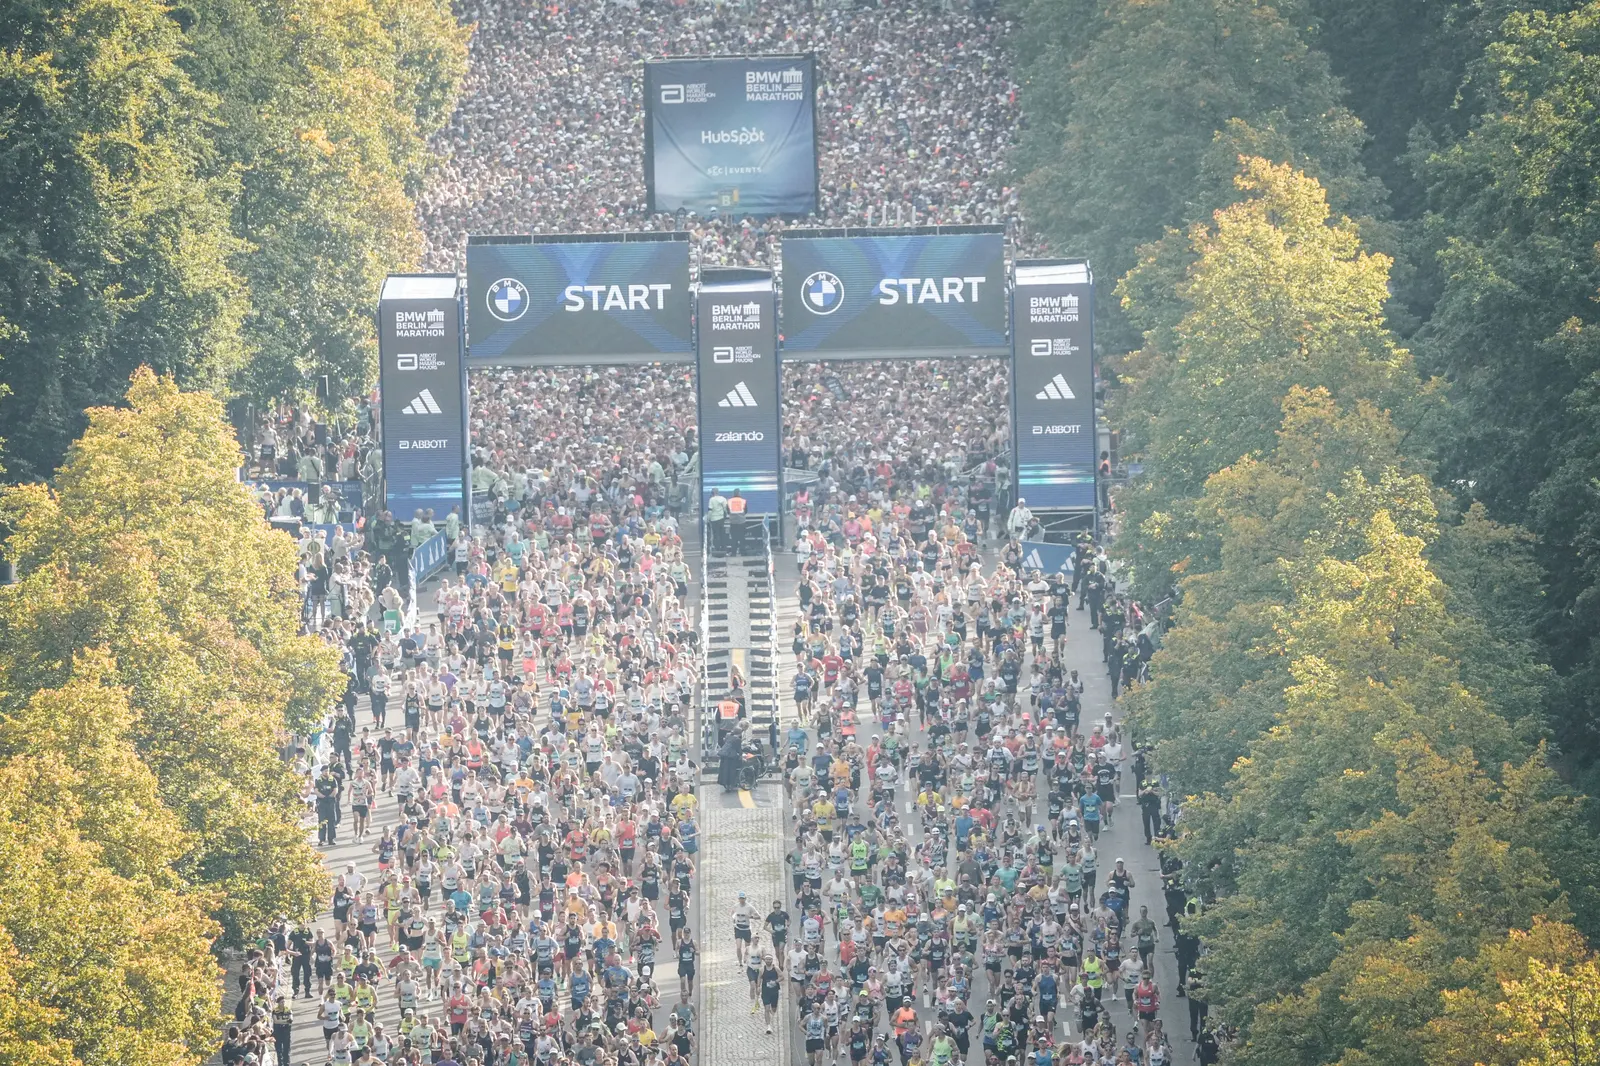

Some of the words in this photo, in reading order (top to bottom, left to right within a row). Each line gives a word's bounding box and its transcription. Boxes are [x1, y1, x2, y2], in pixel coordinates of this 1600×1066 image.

[746, 71, 782, 84] BMW
[746, 84, 782, 92] BERLIN
[746, 92, 803, 101] MARATHON
[701, 127, 765, 145] HubSpot
[807, 273, 838, 286] BMW
[492, 280, 523, 293] BMW
[879, 276, 986, 305] START
[565, 284, 671, 312] START
[1030, 296, 1061, 307] BMW
[712, 304, 742, 315] BMW
[1030, 307, 1061, 315] BERLIN
[396, 311, 426, 322] BMW
[712, 315, 743, 323] BERLIN
[1030, 314, 1079, 323] MARATHON
[396, 322, 427, 330] BERLIN
[712, 322, 760, 330] MARATHON
[396, 329, 445, 337] MARATHON
[1044, 424, 1081, 434] ABBOTT
[715, 431, 764, 442] zalando
[411, 439, 448, 449] ABBOTT
